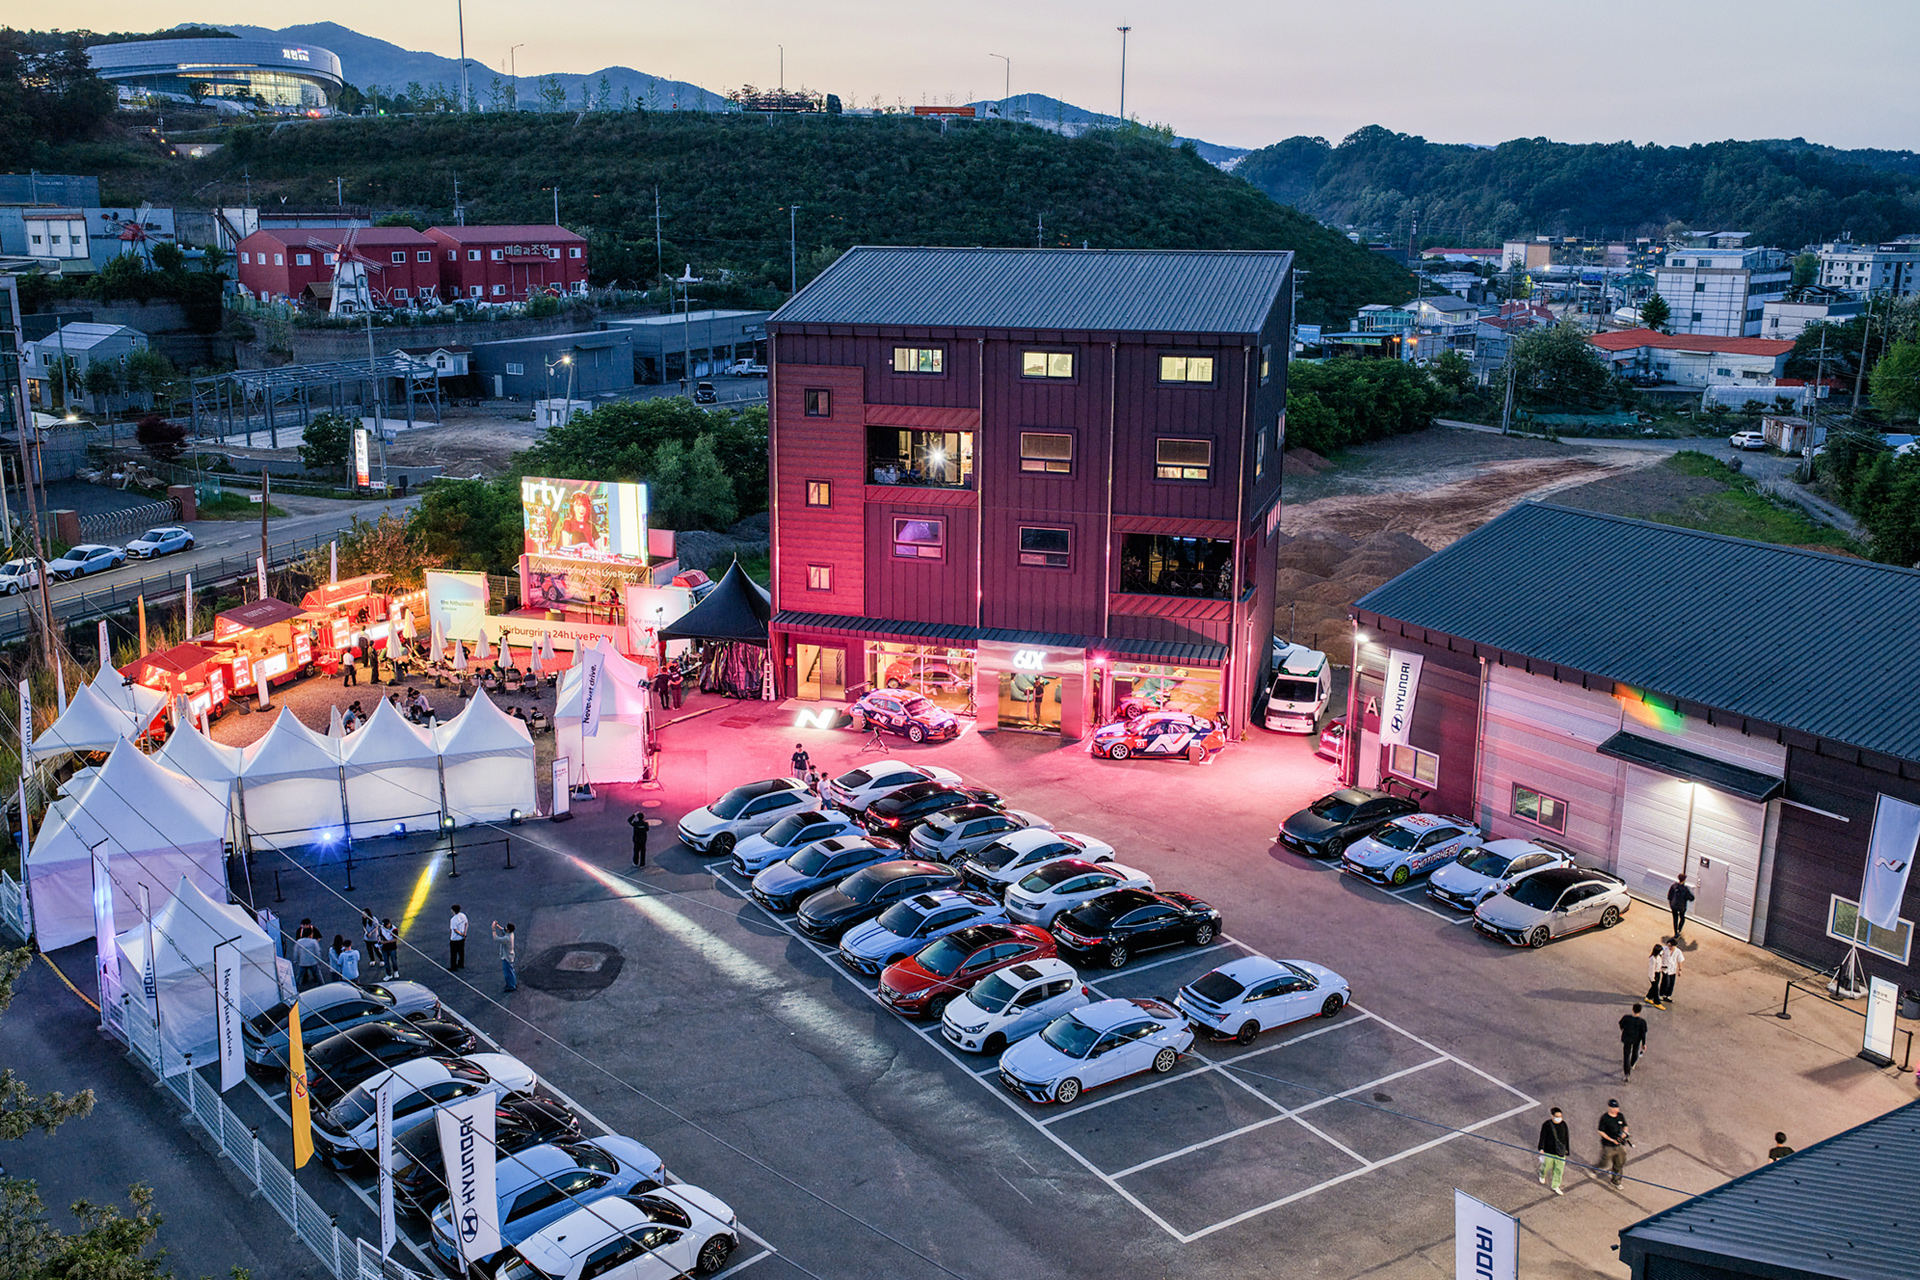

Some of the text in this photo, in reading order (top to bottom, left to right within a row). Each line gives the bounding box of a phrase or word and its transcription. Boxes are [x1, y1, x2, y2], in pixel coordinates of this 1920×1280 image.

[542, 563, 638, 580] Nürburgring 24h Live Party
[553, 630, 569, 639] 24h
[571, 631, 589, 640] Live
[590, 632, 613, 643] Paty
[1395, 662, 1410, 712] HYUNDAI
[1365, 696, 1379, 717] A
[460, 1115, 475, 1206] HYUNDAI
